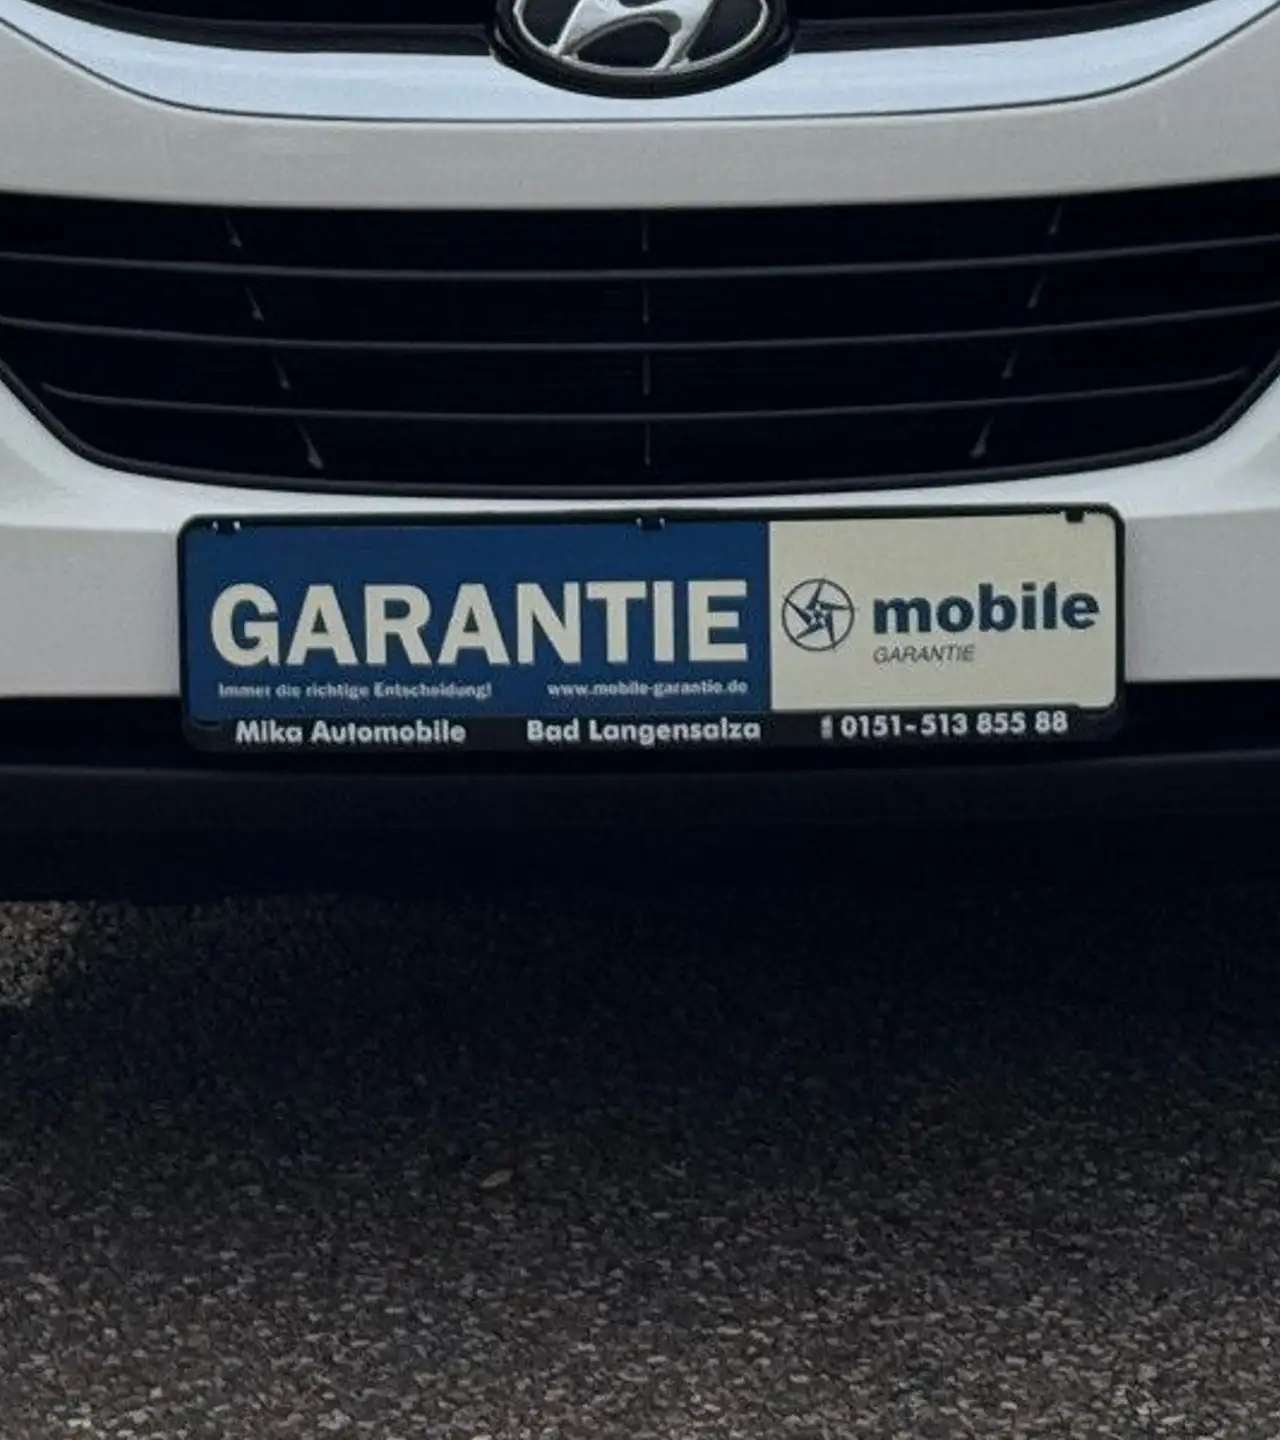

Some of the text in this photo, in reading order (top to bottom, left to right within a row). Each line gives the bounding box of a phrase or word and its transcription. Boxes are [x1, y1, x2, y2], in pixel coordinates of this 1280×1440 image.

[873, 581, 1100, 634] mobile
[210, 580, 748, 667] GARANTIE
[873, 644, 976, 664] GARANTIE
[219, 681, 492, 701] Immer die richtige Entscheidung!
[547, 679, 748, 699] www.mobile-garantie.de
[235, 718, 467, 744] Mika Automobile
[526, 716, 762, 746] Bad Langensalza
[975, 711, 1026, 736] 855
[1034, 710, 1069, 735] 88
